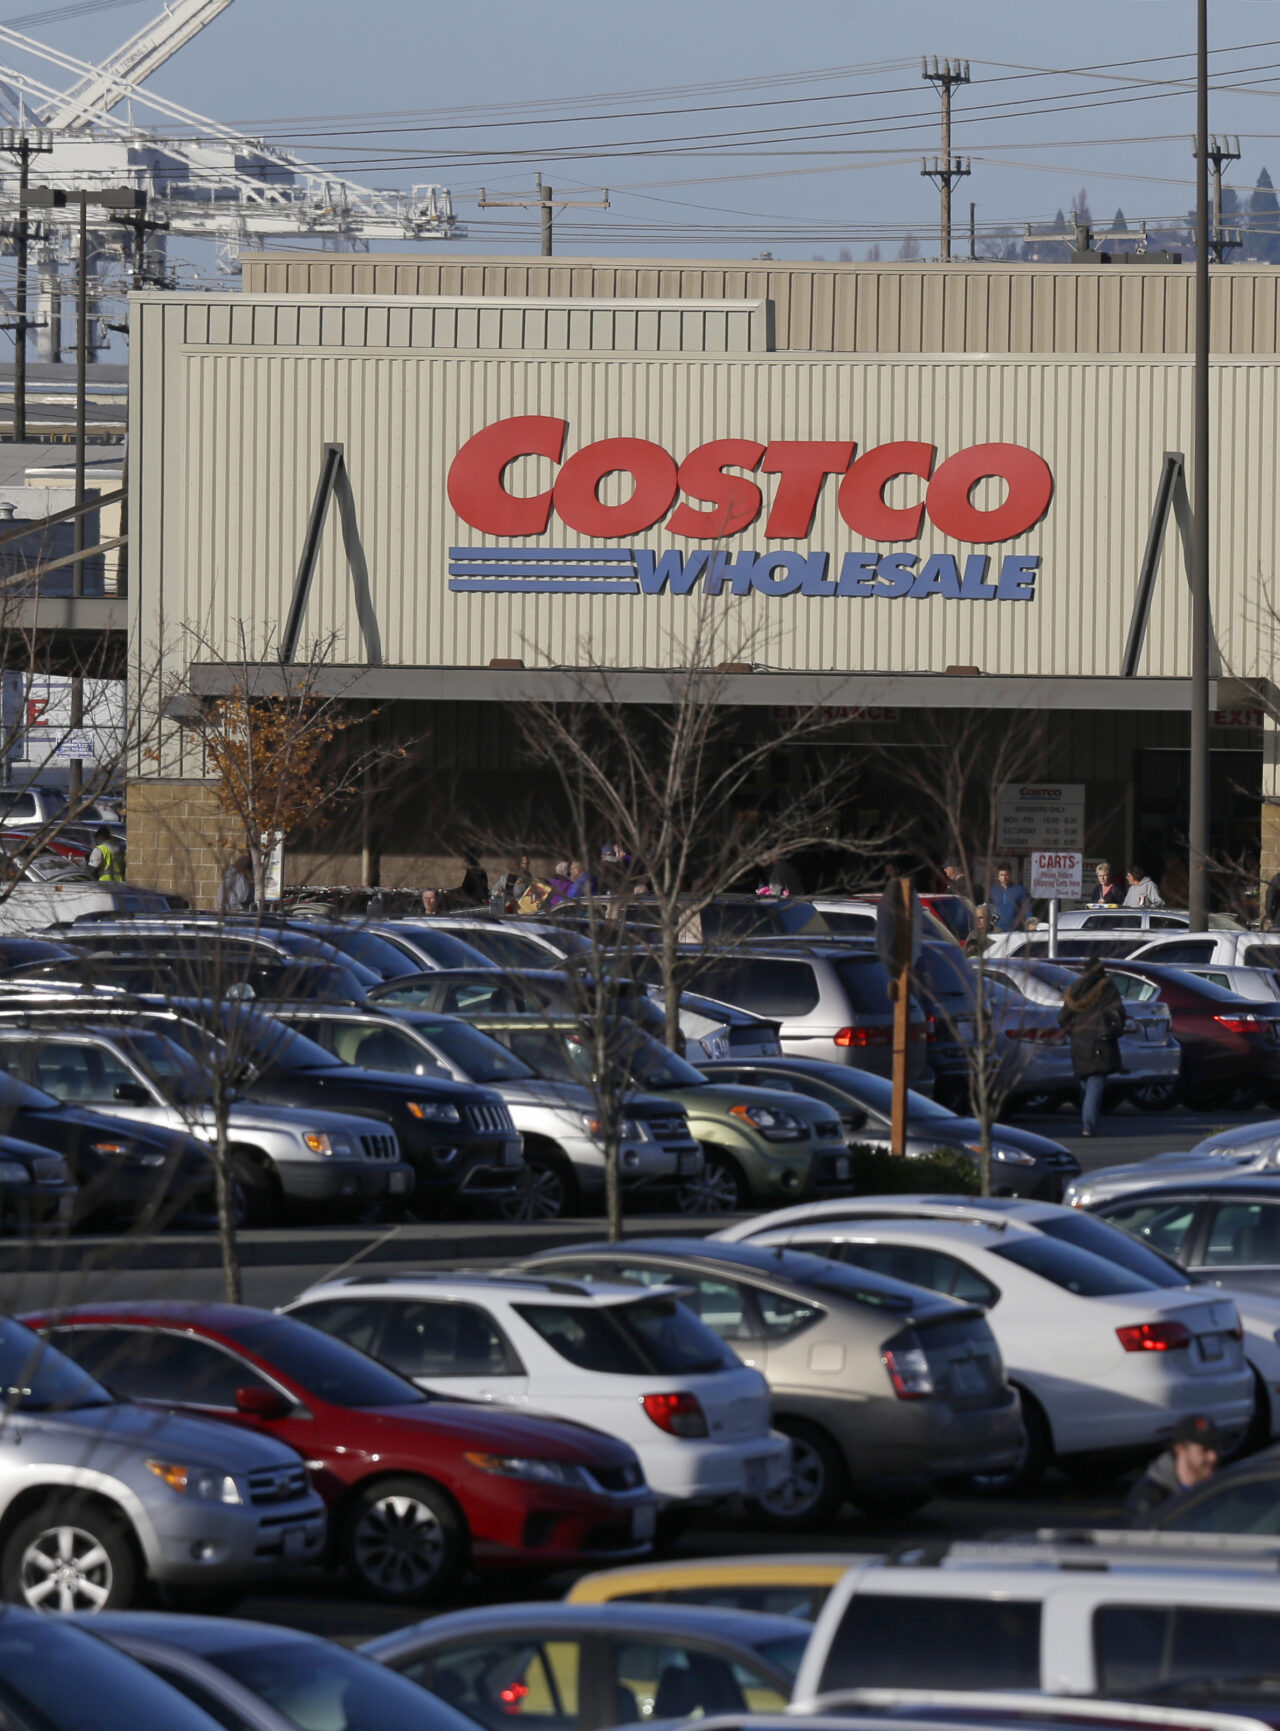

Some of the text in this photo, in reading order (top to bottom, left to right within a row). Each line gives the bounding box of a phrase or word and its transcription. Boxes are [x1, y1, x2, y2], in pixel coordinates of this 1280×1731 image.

[447, 415, 1053, 544] COSTCO
[636, 549, 1040, 600] WHOLESALE
[773, 706, 896, 720] ENTRANCE
[1214, 710, 1264, 725] EXIT
[1019, 787, 1062, 796] COSTCO
[1039, 855, 1075, 868] CARTS
